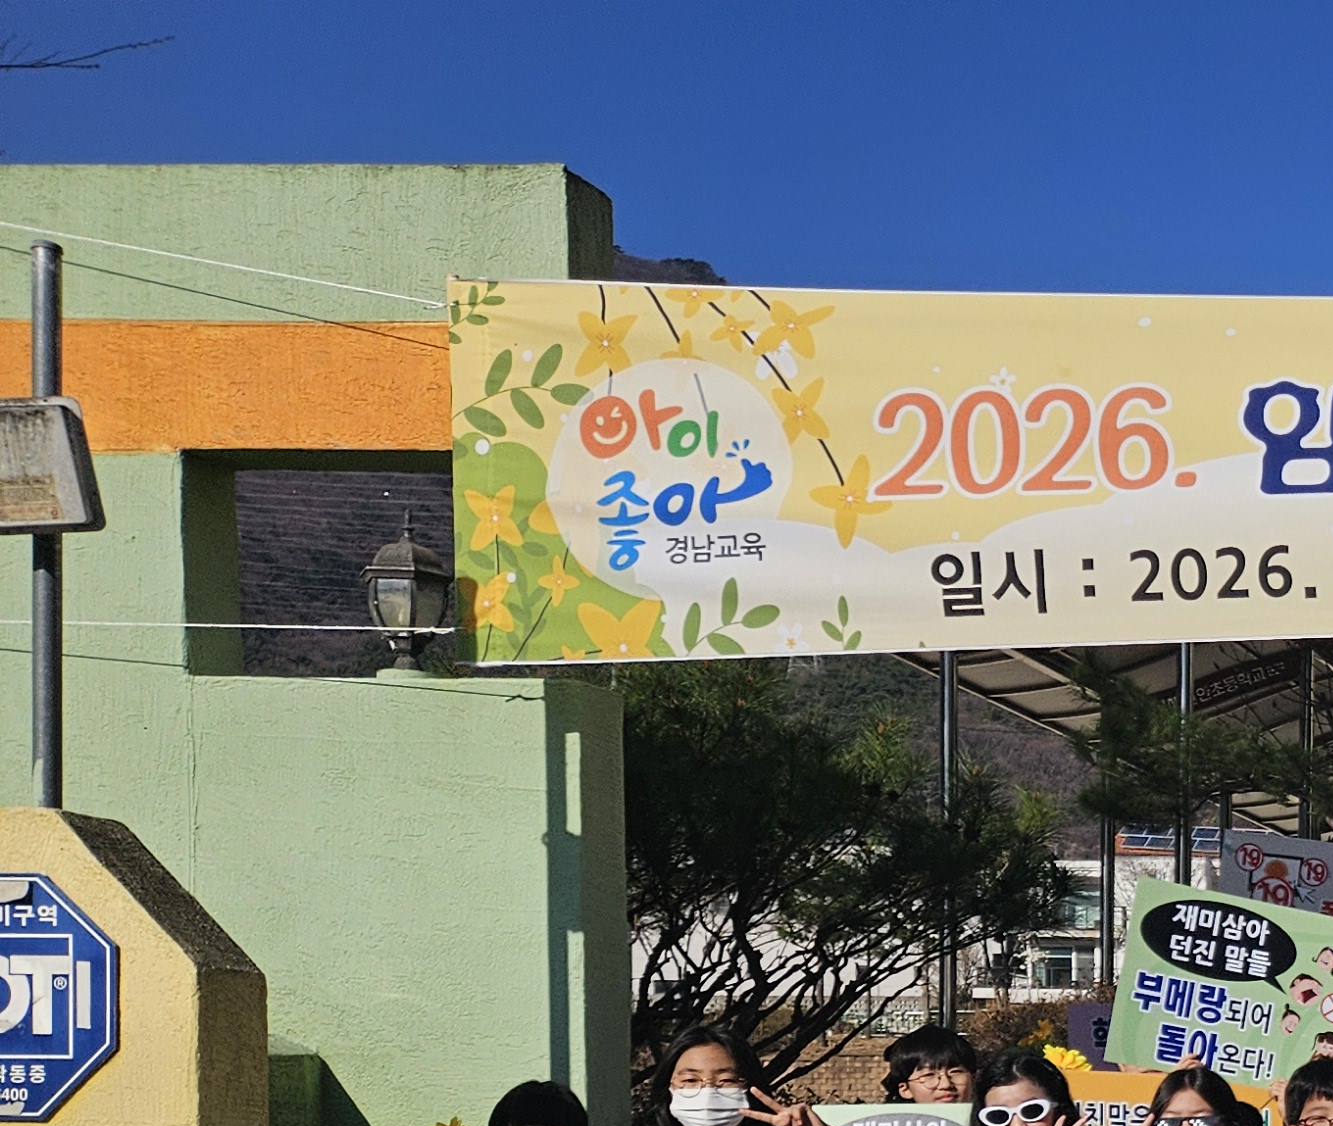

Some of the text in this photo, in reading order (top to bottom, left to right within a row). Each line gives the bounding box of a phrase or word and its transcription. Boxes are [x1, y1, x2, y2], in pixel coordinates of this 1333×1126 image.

[872, 386, 1199, 497] 2026.
[664, 533, 766, 564] 경남교육
[930, 548, 1048, 618] 일시
[1170, 902, 1271, 945] 재미삼아
[1169, 933, 1273, 979] 던진 말들
[1133, 972, 1274, 1035] 부메랑되어
